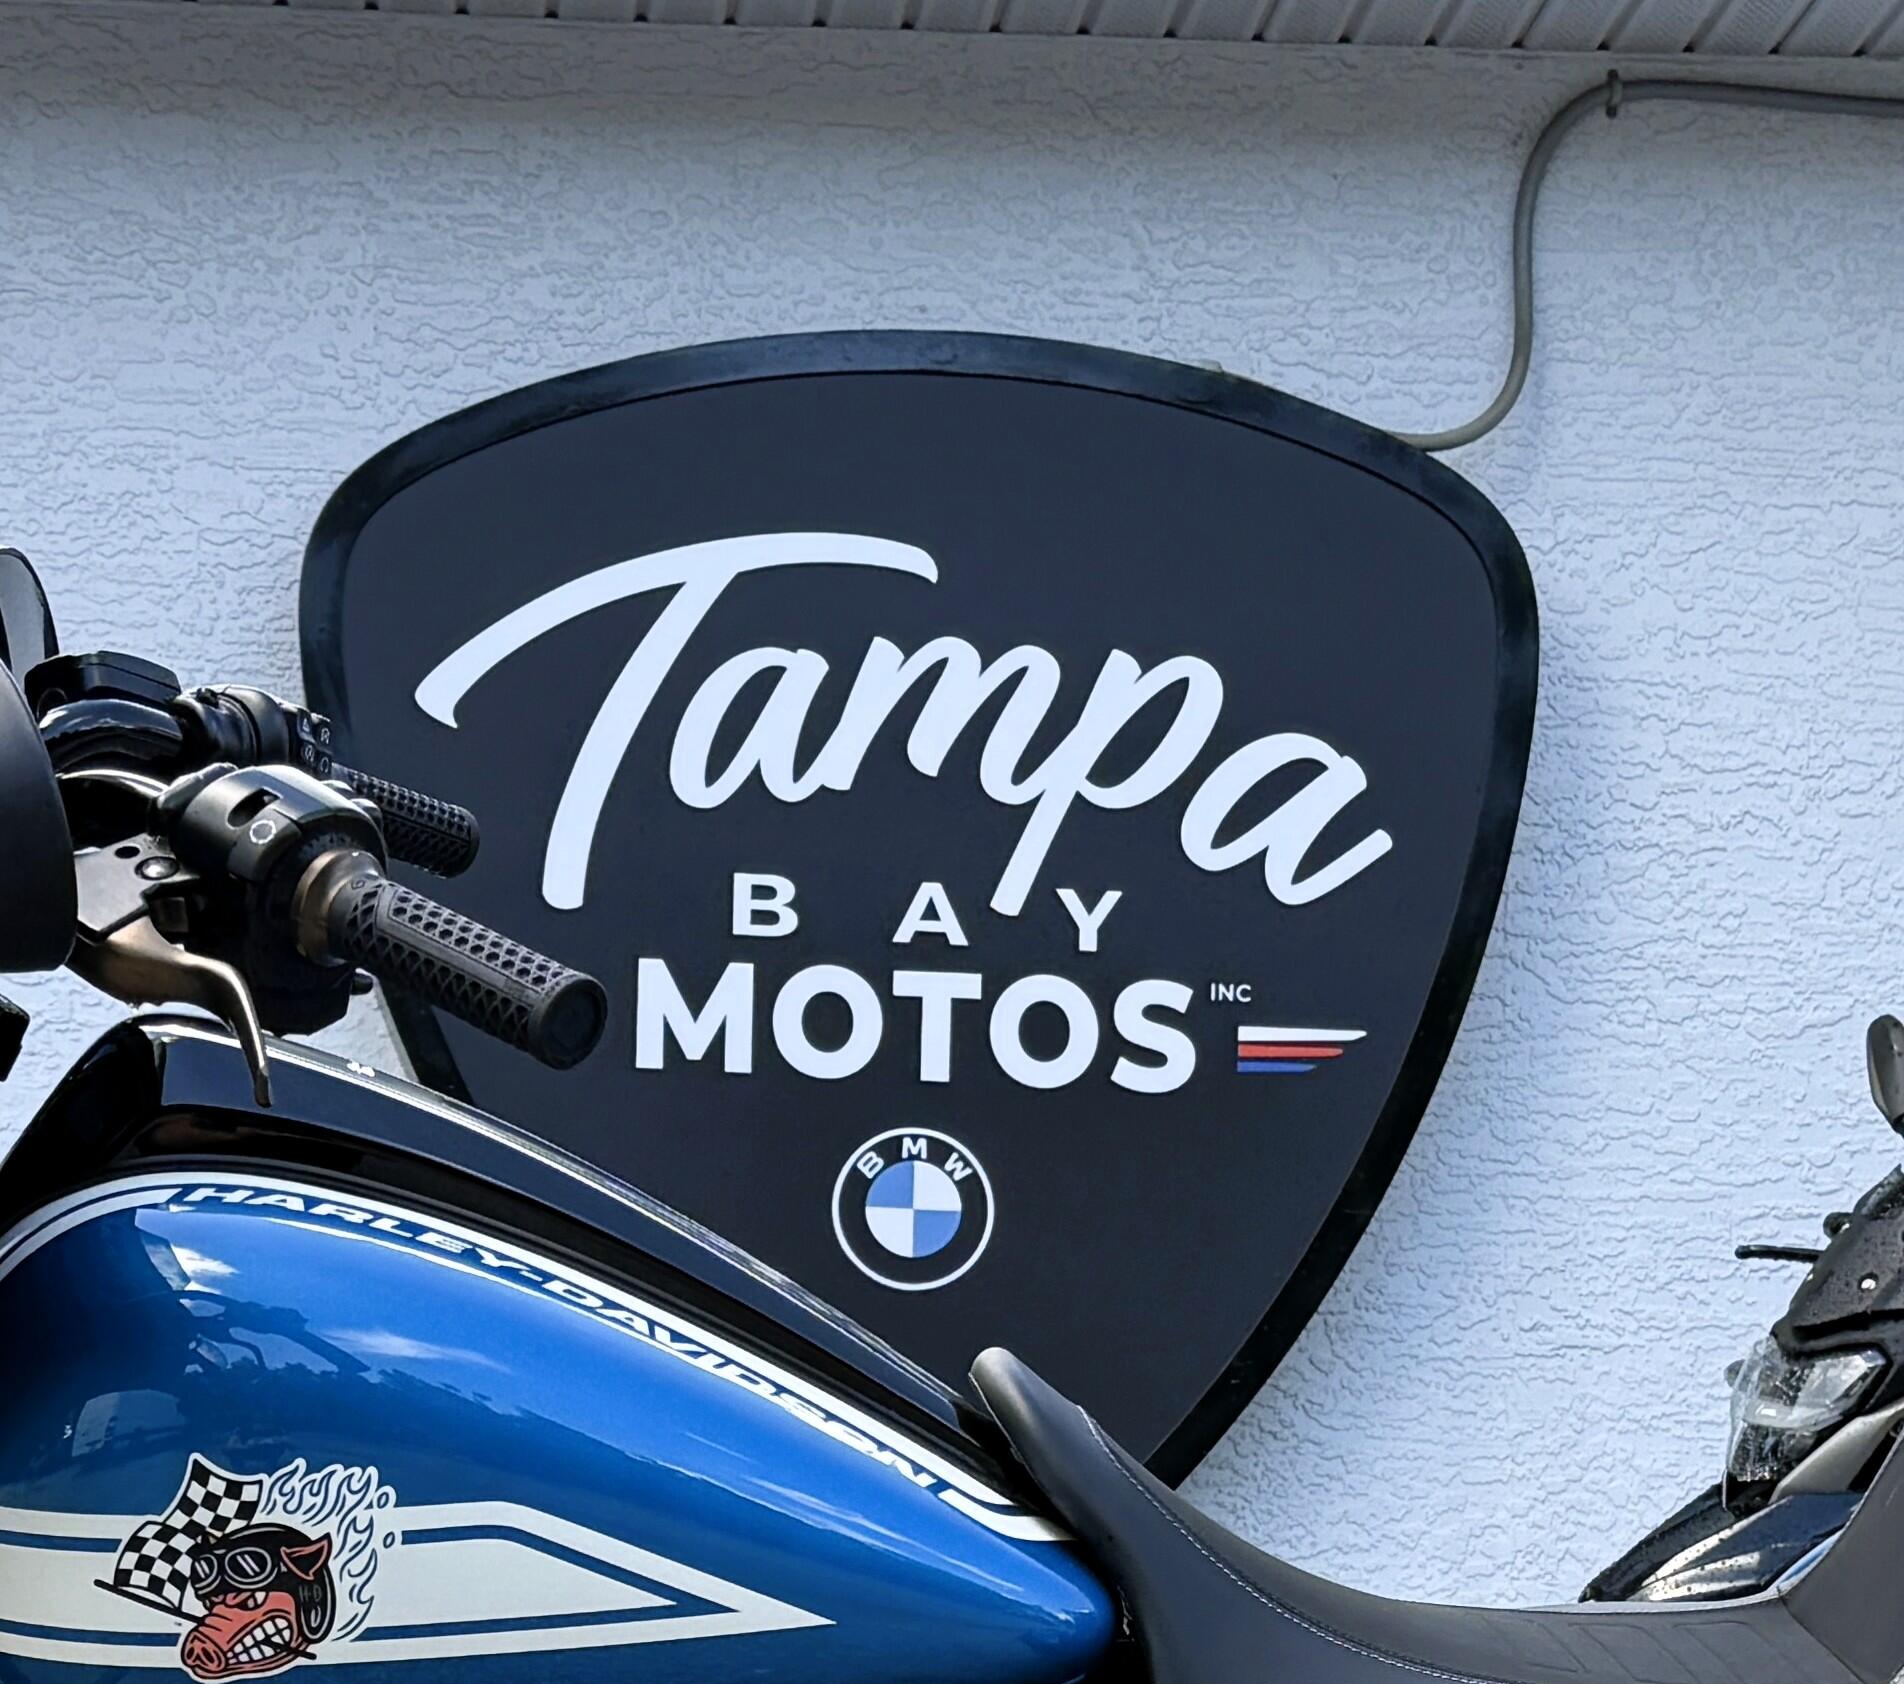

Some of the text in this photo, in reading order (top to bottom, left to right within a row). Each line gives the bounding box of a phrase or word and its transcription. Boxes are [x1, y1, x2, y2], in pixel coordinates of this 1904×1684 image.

[415, 532, 1393, 915] Tampa
[732, 873, 1123, 953] BAY
[635, 958, 1252, 1094] MOTOS INC
[856, 1136, 973, 1182] BMW
[183, 1187, 938, 1488] HARLEY-DAVIDSON
